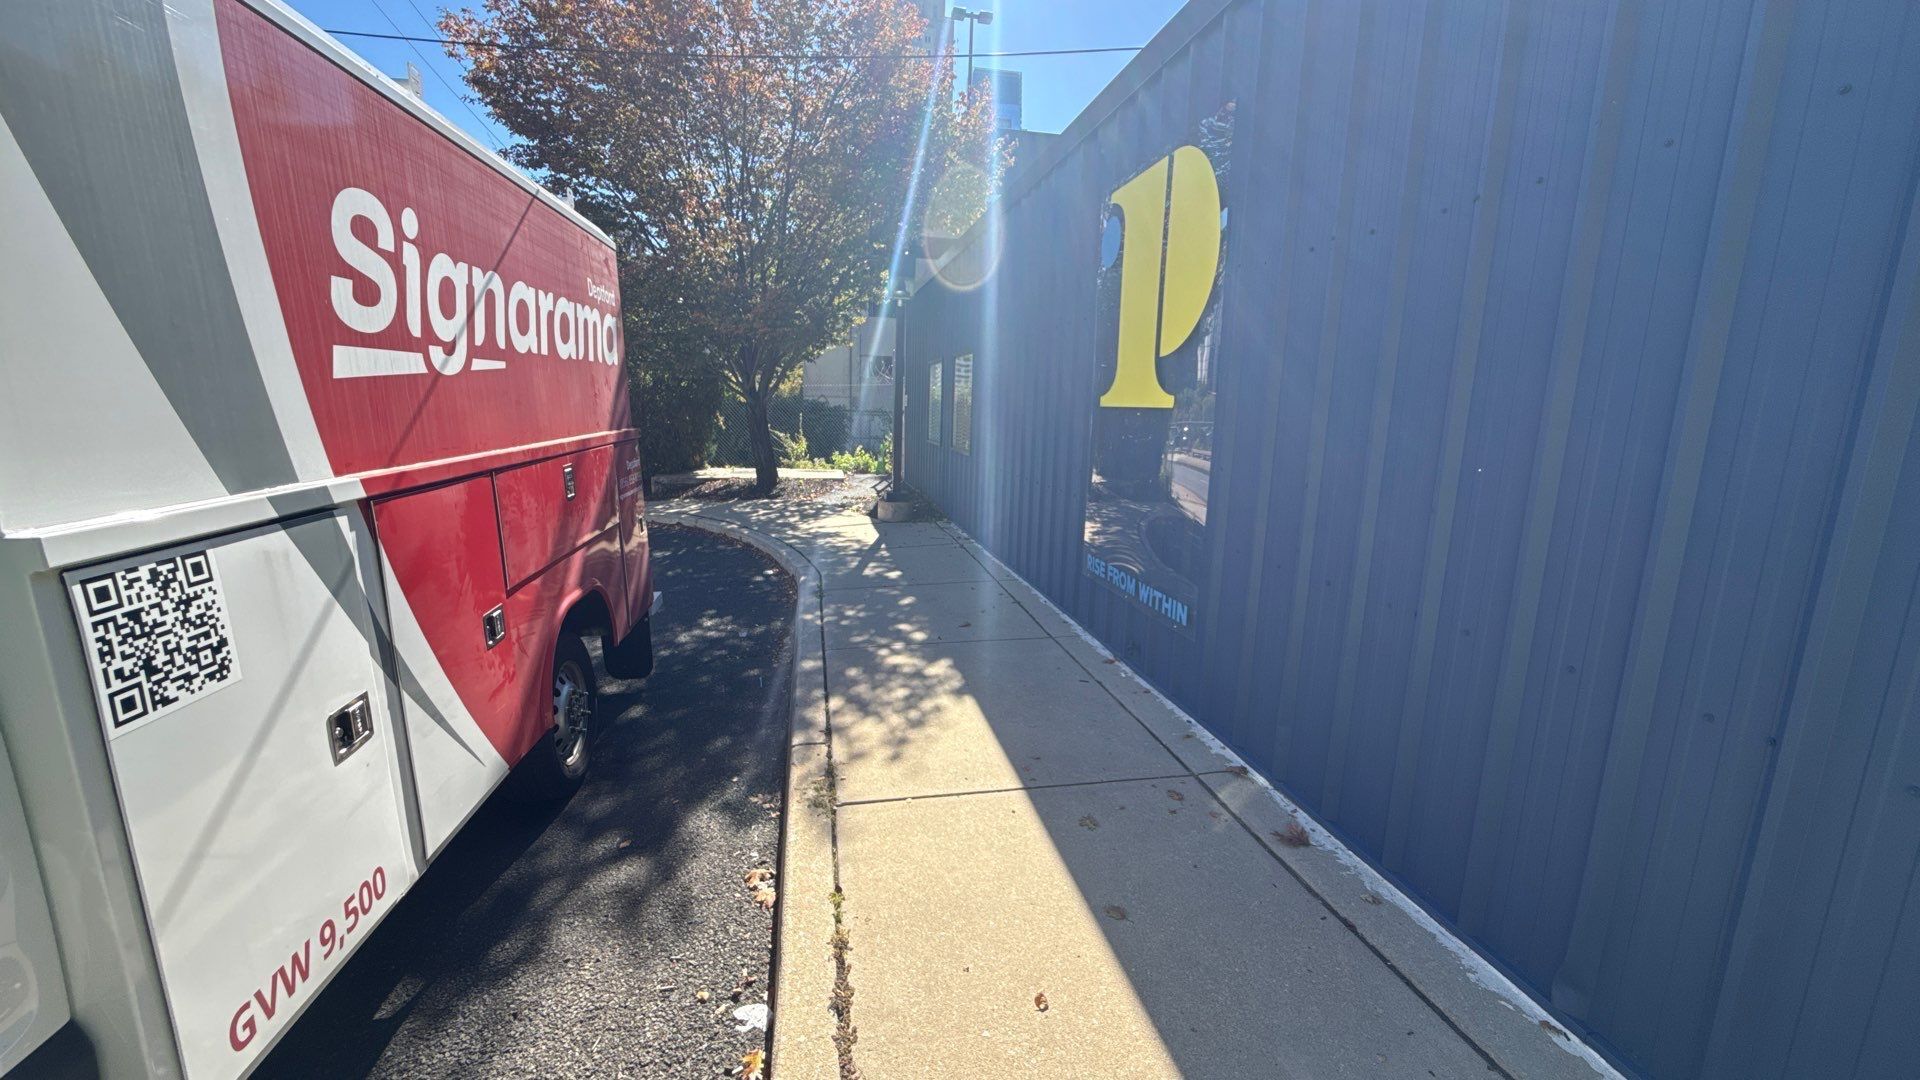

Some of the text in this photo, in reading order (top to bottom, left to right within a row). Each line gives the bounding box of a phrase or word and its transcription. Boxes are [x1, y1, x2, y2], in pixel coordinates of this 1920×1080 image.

[331, 187, 619, 376] Signarama
[1087, 554, 1188, 626] RISE FROM WITHIN
[229, 866, 386, 1052] GVW 9,500
